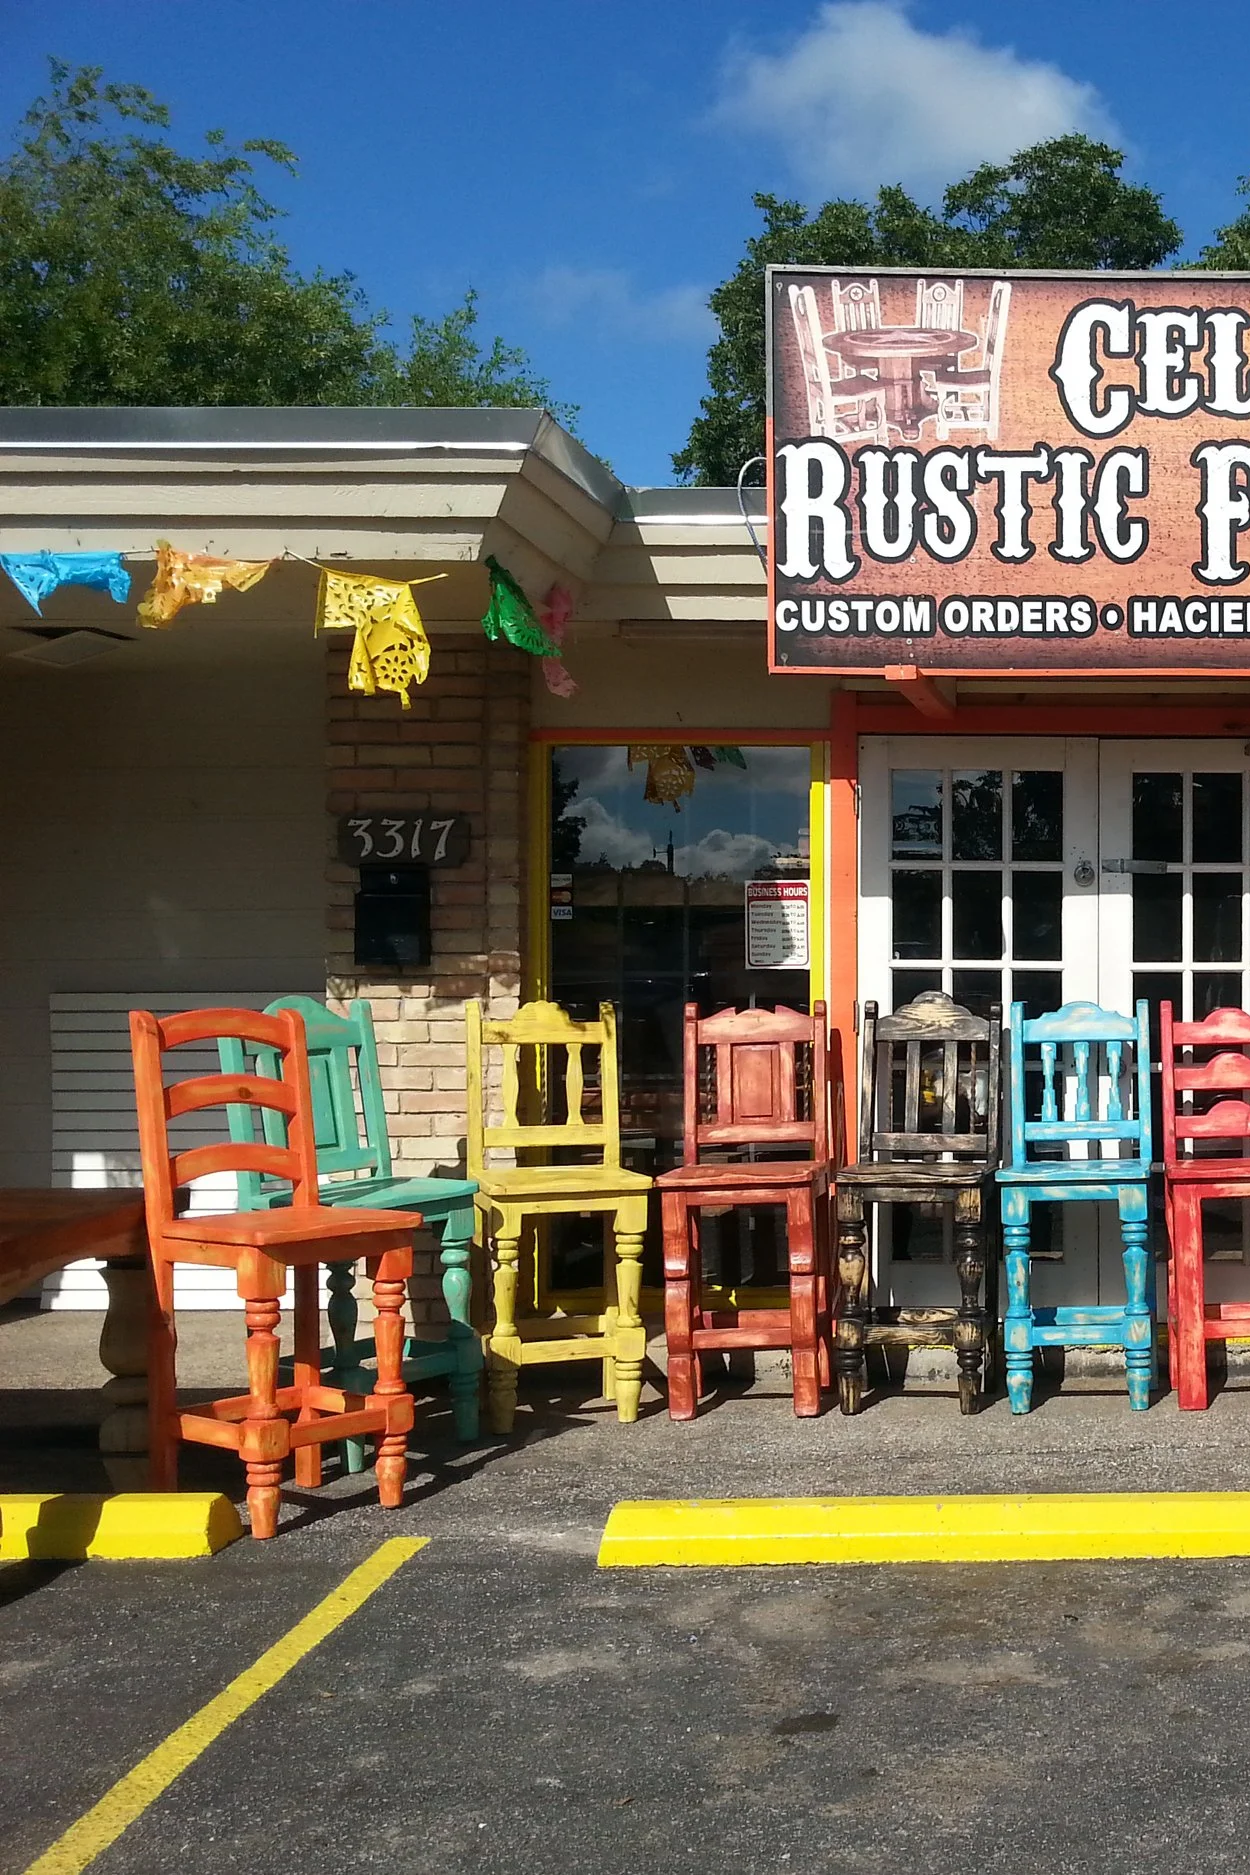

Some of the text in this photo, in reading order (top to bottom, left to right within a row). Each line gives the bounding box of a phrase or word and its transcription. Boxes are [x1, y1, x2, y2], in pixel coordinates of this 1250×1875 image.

[775, 443, 1144, 579] RUSTIC
[775, 599, 931, 632] CUSTOM
[943, 600, 1093, 633] ORDERS
[347, 818, 457, 861] 3317
[748, 887, 808, 897] BUSINESS HOURS
[553, 908, 571, 916] VISA
